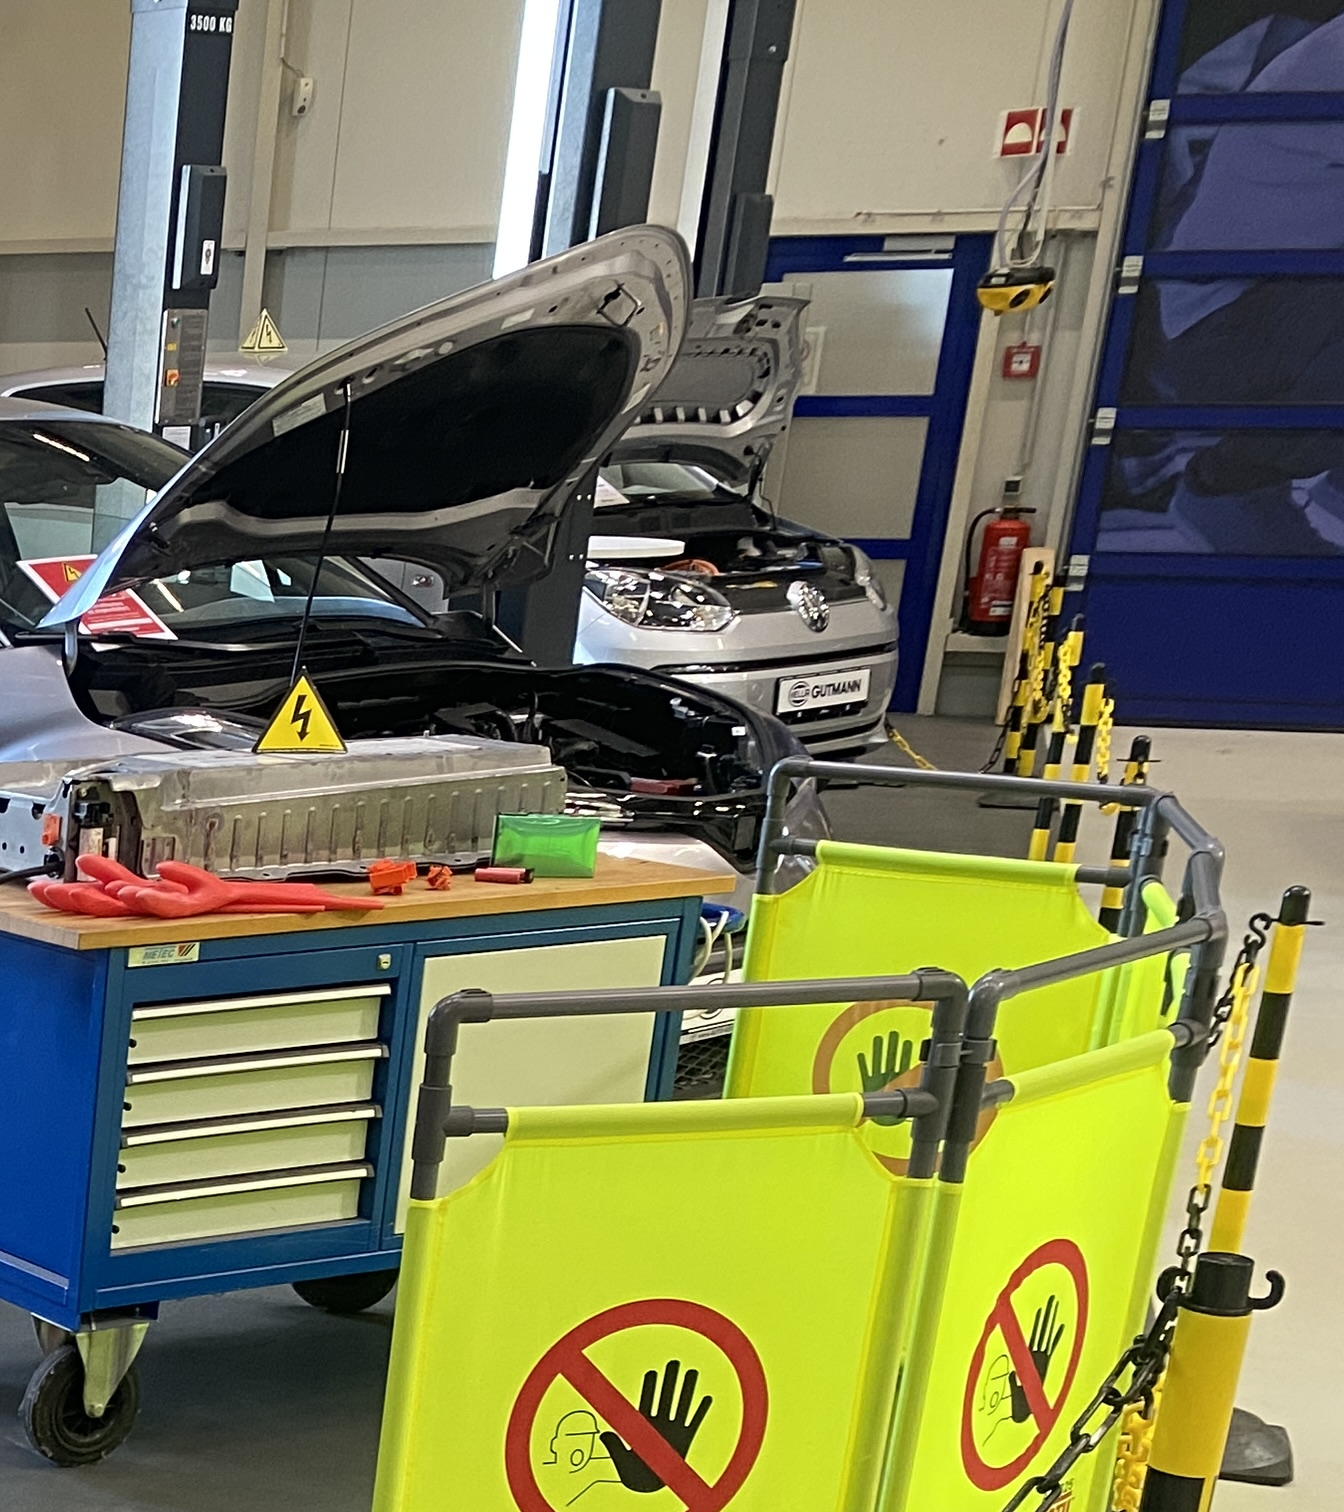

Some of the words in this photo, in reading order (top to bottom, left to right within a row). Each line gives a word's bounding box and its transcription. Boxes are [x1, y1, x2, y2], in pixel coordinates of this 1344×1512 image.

[190, 14, 216, 32] 3500
[219, 16, 232, 33] KG
[812, 680, 862, 698] GUTMANN
[143, 947, 175, 960] METEC
